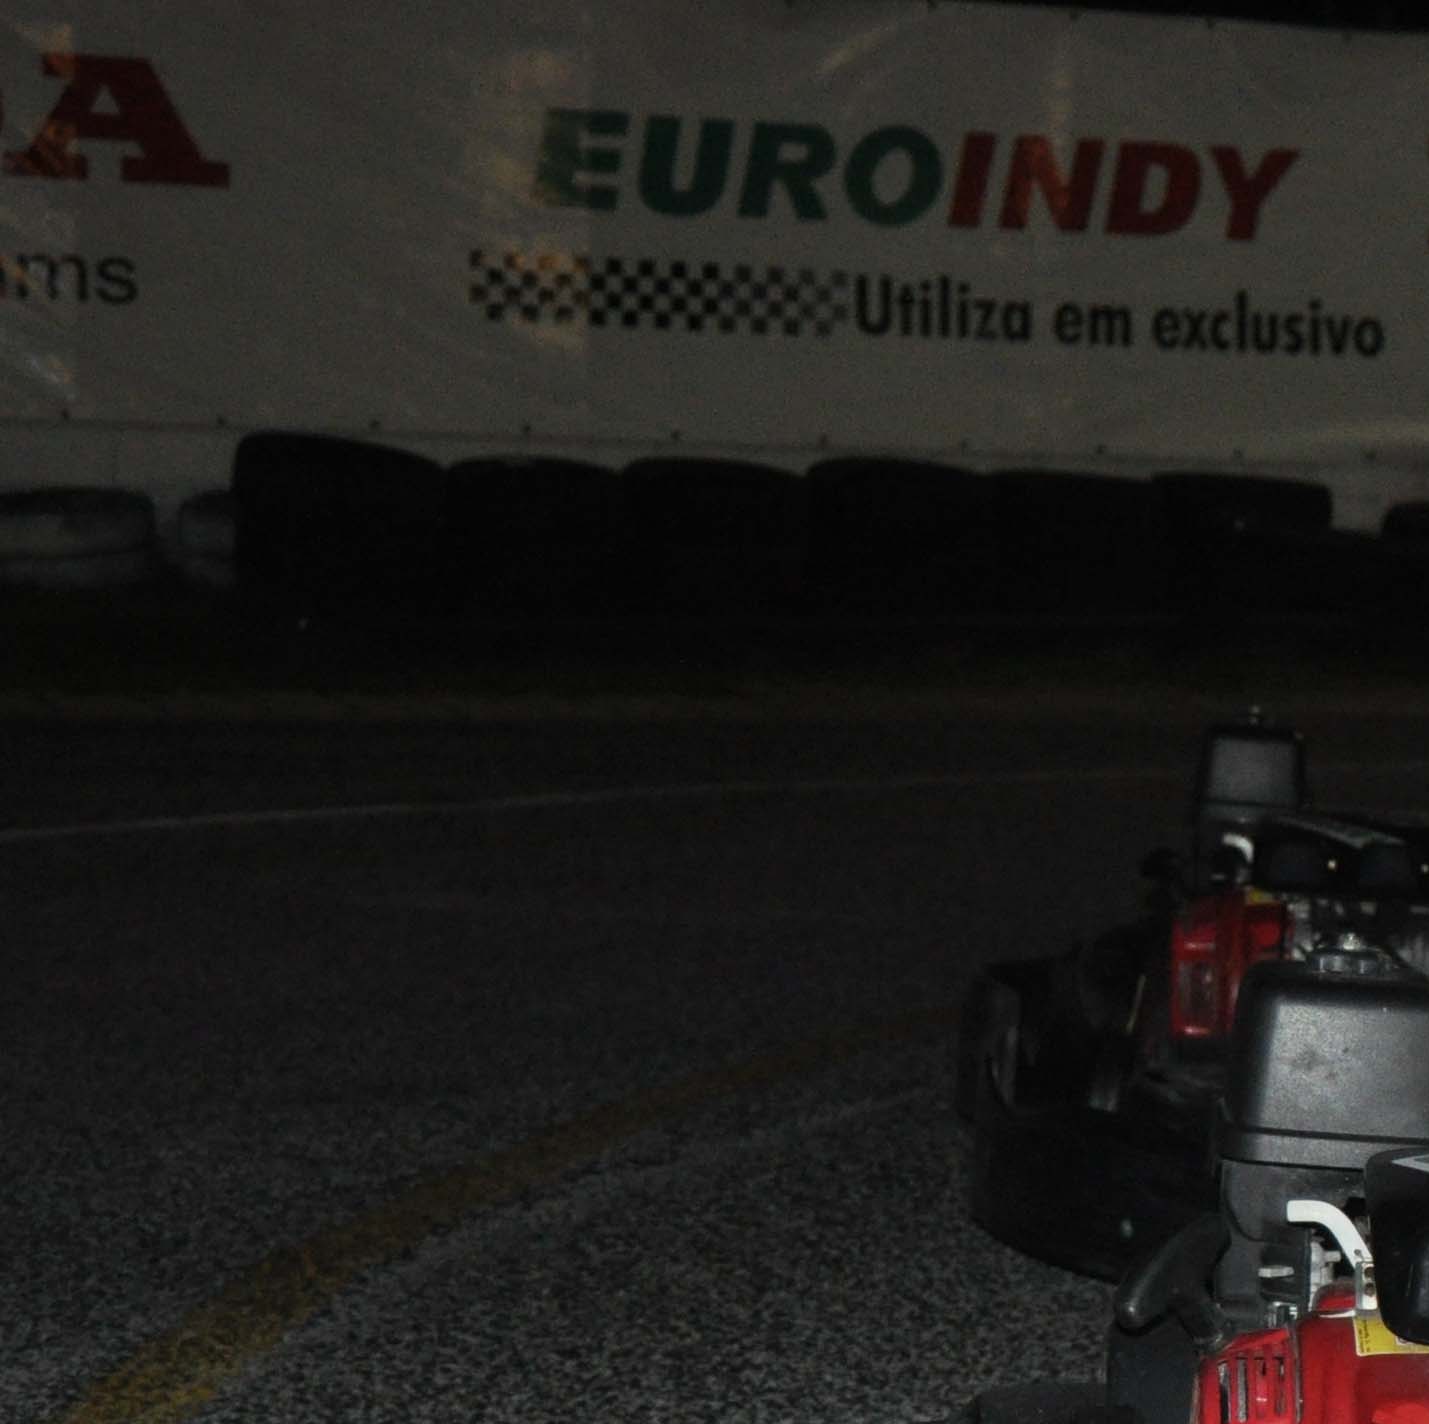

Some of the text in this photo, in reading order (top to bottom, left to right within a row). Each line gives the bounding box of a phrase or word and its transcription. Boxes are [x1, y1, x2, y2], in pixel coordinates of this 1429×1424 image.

[535, 108, 1301, 241] EUROINDY
[0, 254, 138, 304] ms
[854, 273, 1385, 358] Utiliza em exclusivo
